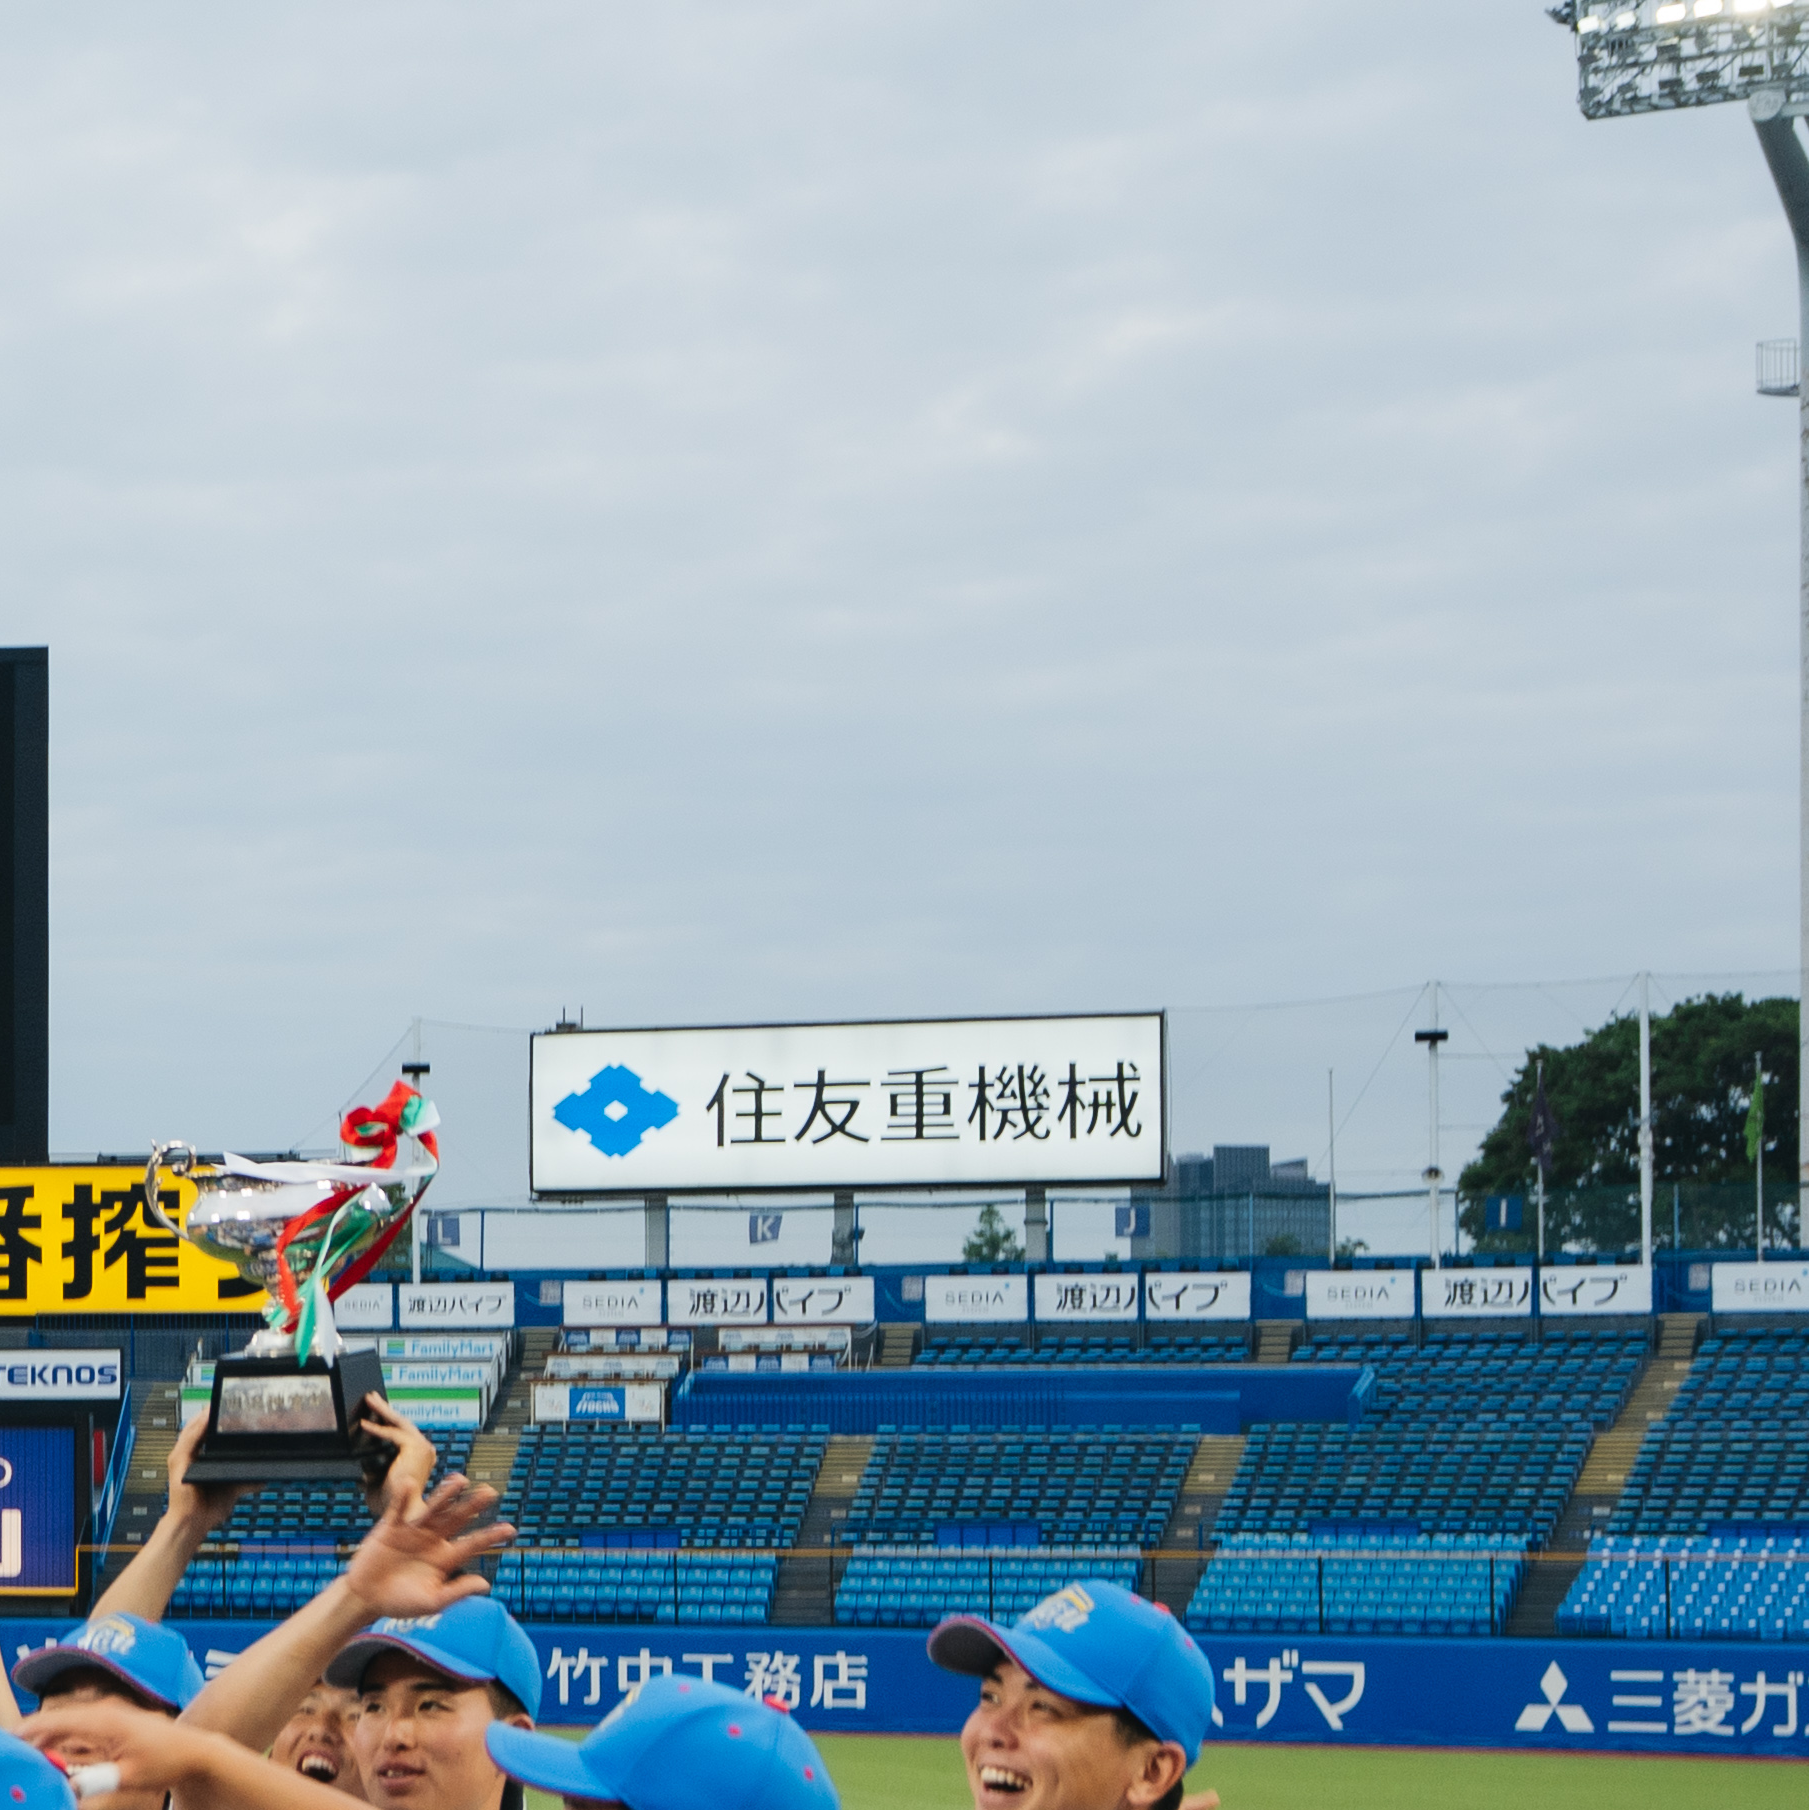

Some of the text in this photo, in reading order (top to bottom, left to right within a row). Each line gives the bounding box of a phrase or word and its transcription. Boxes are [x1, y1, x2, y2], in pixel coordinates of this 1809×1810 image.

[705, 1060, 1142, 1148] 住友重機械
[436, 1217, 453, 1246] L
[757, 1213, 777, 1242] K
[1123, 1207, 1136, 1237] J
[583, 1295, 639, 1310] SEDIA
[945, 1290, 1004, 1306] SEDIA
[1327, 1285, 1390, 1301] SEDIA
[412, 1340, 493, 1359] FamilyMart
[399, 1365, 482, 1383] FamilyMart
[1212, 1648, 1366, 1731] ザマ
[1607, 1667, 1809, 1737] 三菱ガ
